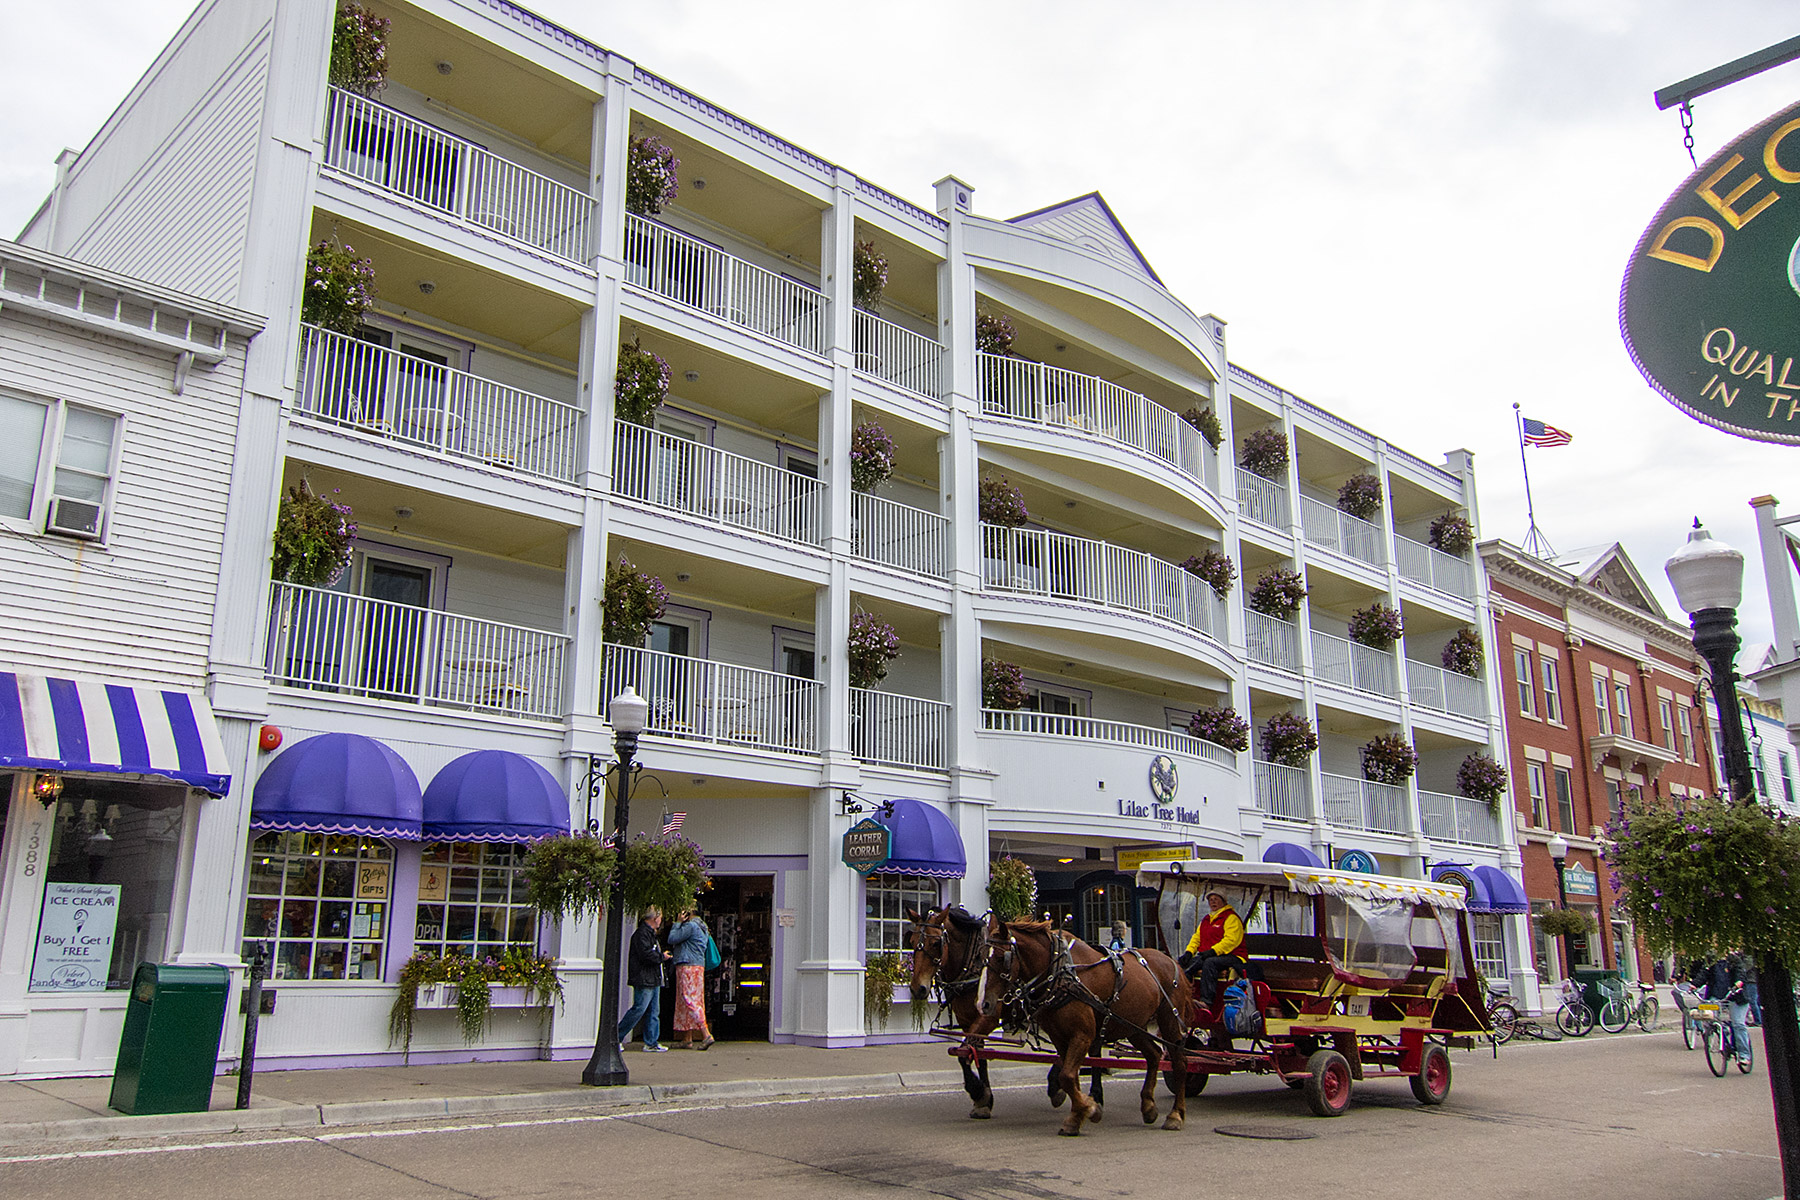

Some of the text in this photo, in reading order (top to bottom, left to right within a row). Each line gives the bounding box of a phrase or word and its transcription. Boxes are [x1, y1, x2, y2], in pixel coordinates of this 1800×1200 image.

[1701, 327, 1800, 390] QUAL
[1700, 374, 1740, 408] IN
[1118, 799, 1200, 825] Lilac Tree Hotel
[849, 832, 882, 845] LEATHER
[24, 821, 42, 876] 7388
[849, 845, 882, 857] CORRAL
[362, 885, 384, 895] GIFTS
[50, 896, 115, 907] ICE CREAM
[416, 923, 442, 940] OPEN
[43, 935, 66, 946] Buy
[80, 935, 101, 945] Get
[62, 946, 90, 956] FREE
[1351, 1003, 1363, 1014] TAXI
